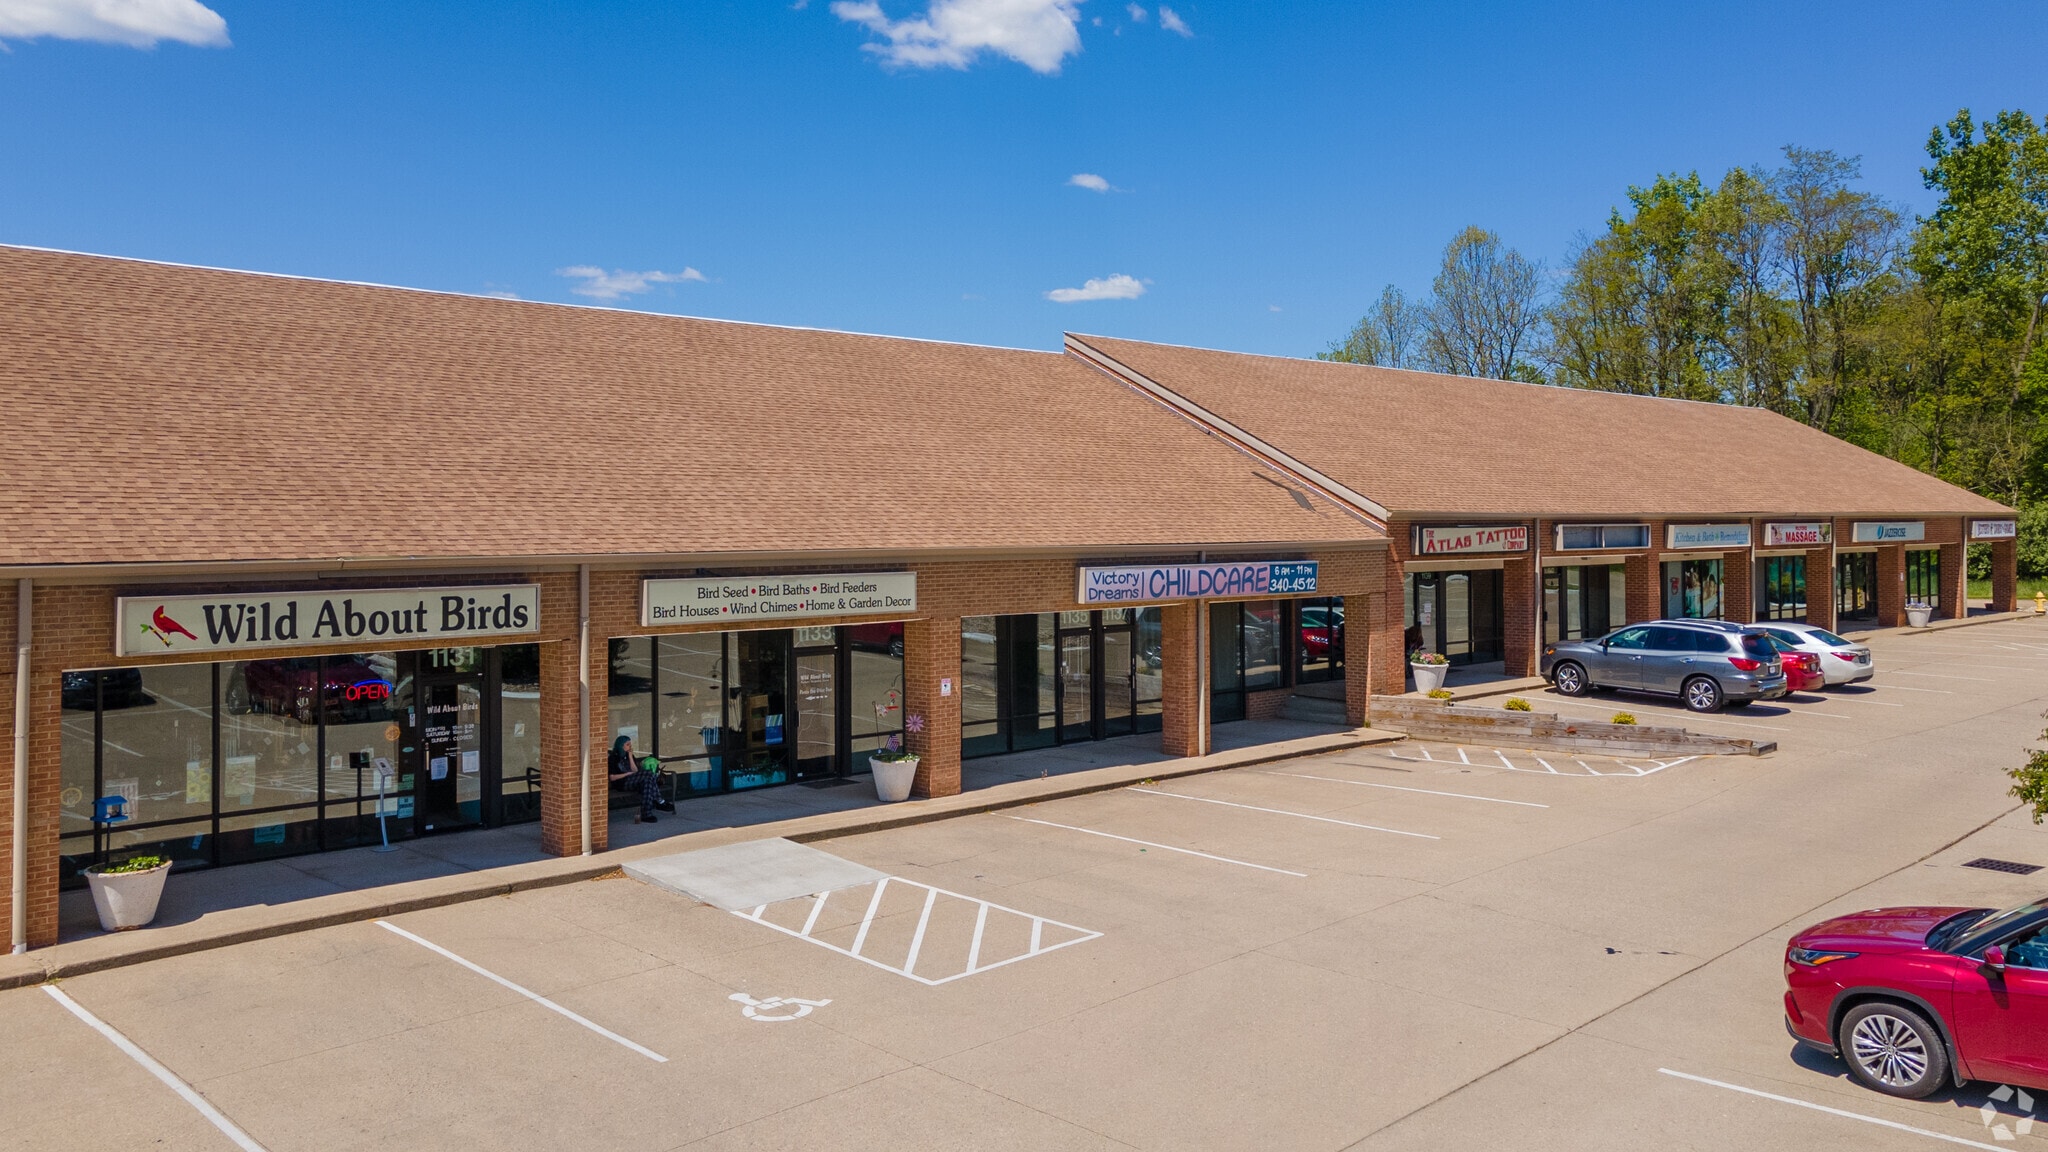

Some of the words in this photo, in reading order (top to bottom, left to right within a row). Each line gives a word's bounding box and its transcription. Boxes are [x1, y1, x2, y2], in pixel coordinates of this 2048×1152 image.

[1426, 535, 1472, 553] ATLAS
[1476, 528, 1526, 546] TATTOO
[1785, 531, 1817, 542] MASSAGE
[1274, 566, 1280, 576] 6
[1281, 567, 1291, 576] AM
[1296, 565, 1304, 575] 11
[1304, 566, 1313, 575] PM
[697, 586, 720, 599] Bird
[722, 585, 749, 598] Seed
[758, 584, 780, 597] Bird
[783, 583, 810, 596] Baths
[820, 582, 840, 595] Bird
[842, 581, 877, 594] Feeders
[1092, 571, 1140, 587] Victory
[1149, 566, 1268, 598] CHILDCARE
[1269, 577, 1316, 592] 340-4512
[1088, 587, 1139, 600] Dreams
[653, 605, 676, 619] Bird
[679, 604, 719, 617] Houses
[730, 601, 757, 615] Wind
[760, 600, 798, 613] Chimes
[806, 599, 835, 611] Home
[838, 598, 846, 609] &
[849, 597, 882, 609] Garden
[885, 595, 911, 608] Decor
[203, 601, 299, 645] Wild
[312, 598, 428, 639] About
[440, 594, 529, 632] Birds
[797, 627, 832, 641] 1133
[428, 648, 475, 668] 1131
[346, 684, 389, 701] OPEN
[427, 705, 441, 715] Wild
[442, 704, 461, 713] About
[462, 702, 478, 711] Birds
